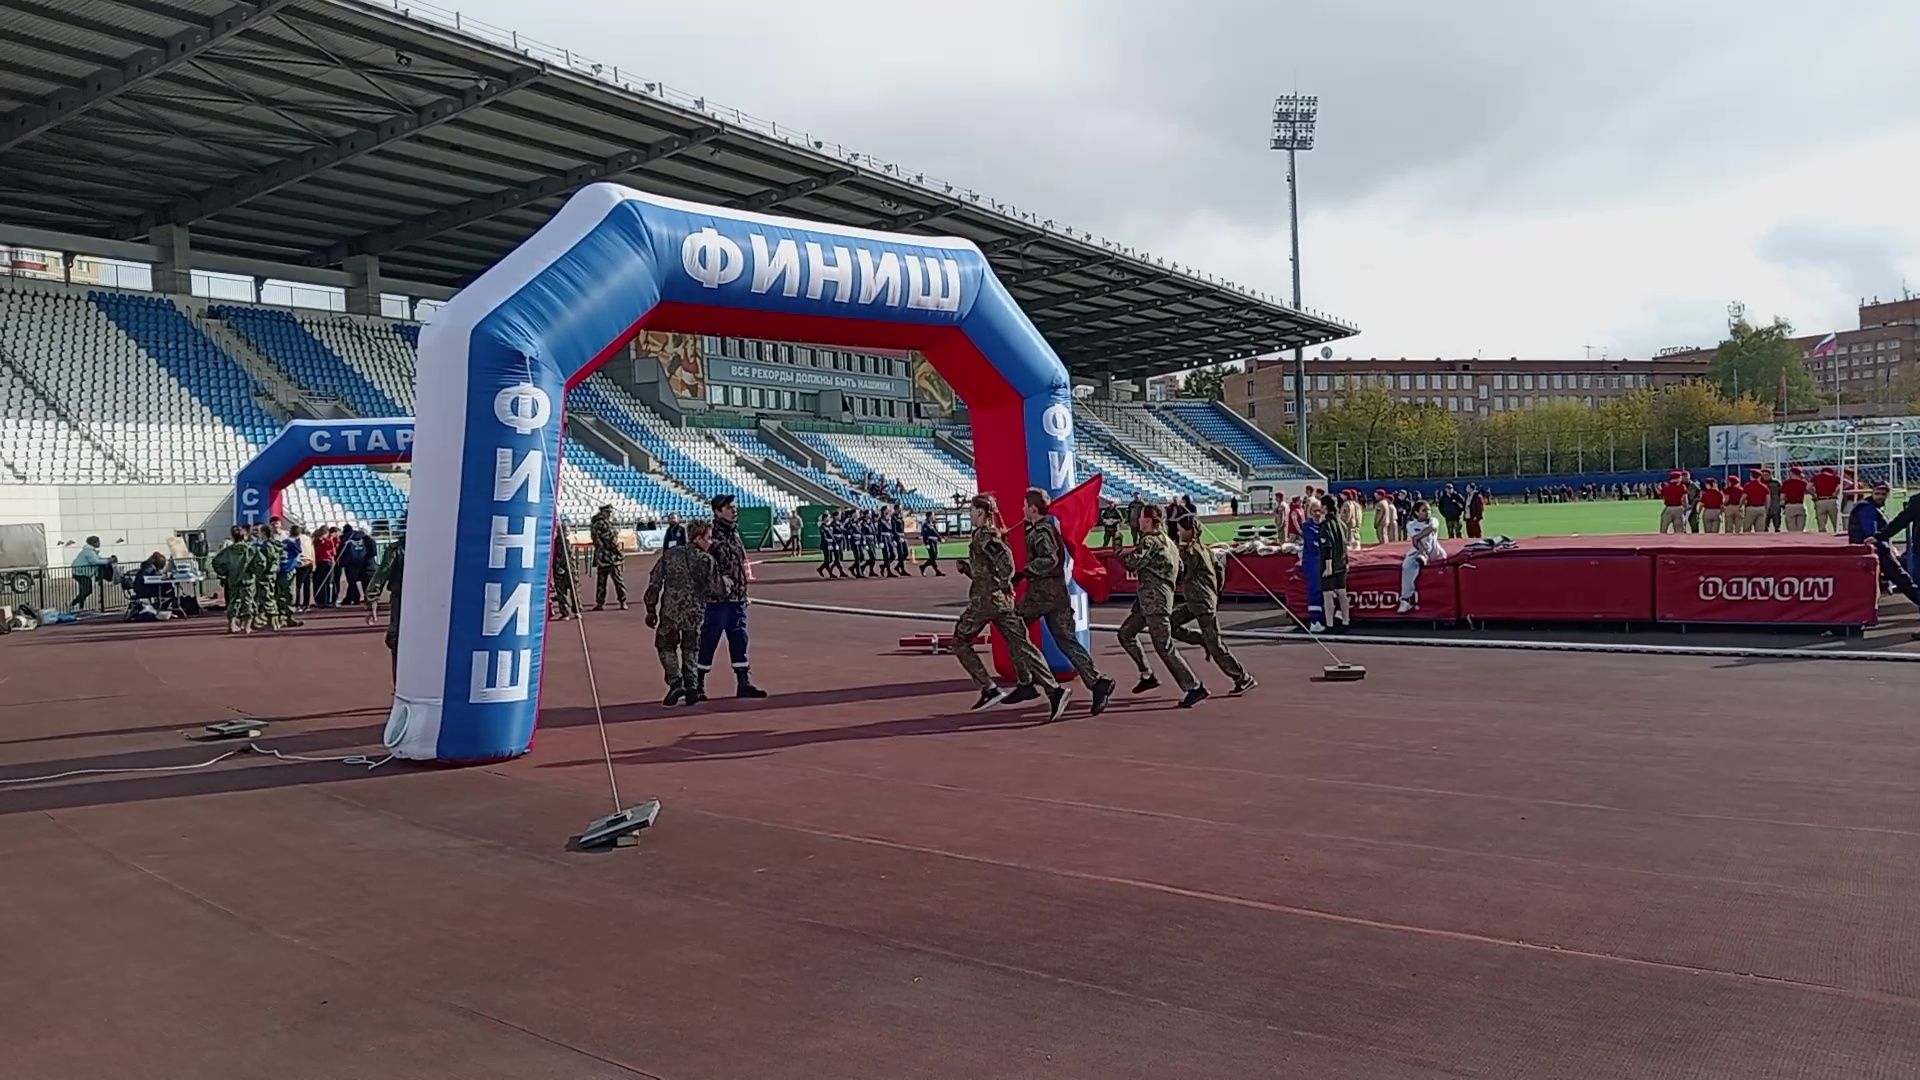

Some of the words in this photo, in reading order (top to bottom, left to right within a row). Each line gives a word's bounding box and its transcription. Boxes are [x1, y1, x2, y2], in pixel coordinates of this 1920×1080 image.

[681, 226, 961, 312] ФИНИШ
[1659, 345, 1693, 356] ОТЕЛЬ
[731, 365, 750, 377] ВСЕ
[752, 367, 794, 382] РЕКОРДЫ
[795, 372, 833, 385] ДОЛЖНЫ
[835, 376, 857, 388] БЫТЬ
[468, 382, 551, 704] ФИНИШ
[1699, 576, 1834, 601] MONDO
